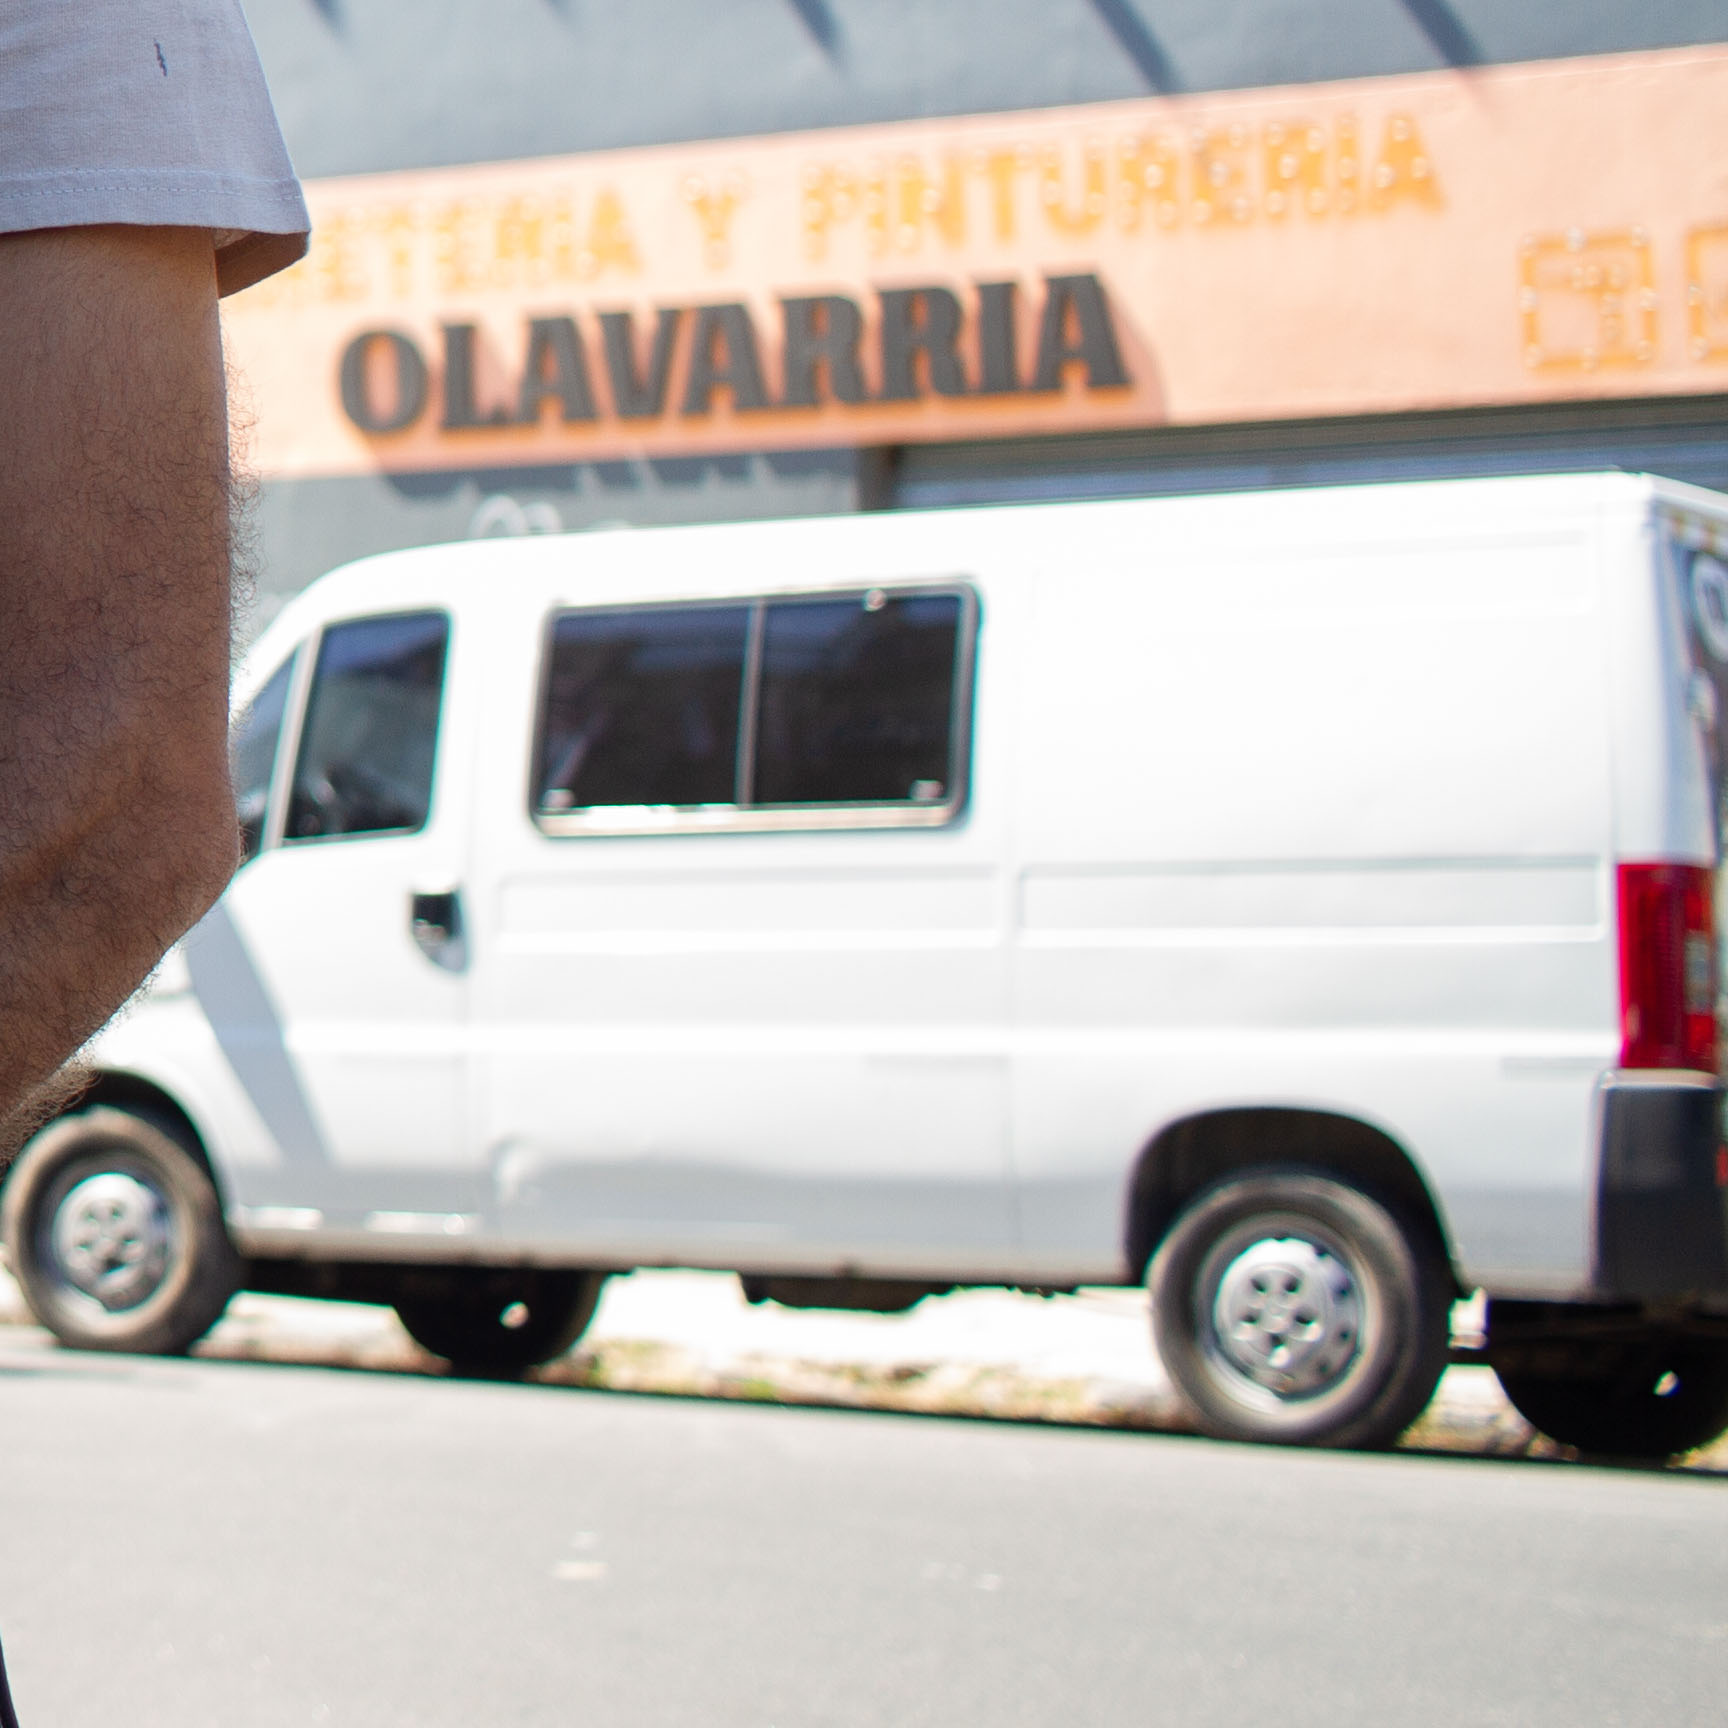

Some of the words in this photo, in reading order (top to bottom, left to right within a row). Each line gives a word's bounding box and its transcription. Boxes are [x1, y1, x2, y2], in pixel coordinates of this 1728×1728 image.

[680, 168, 750, 271] Y
[799, 112, 1448, 262] PINTURERIA
[340, 273, 1130, 436] OLAVARRIA
